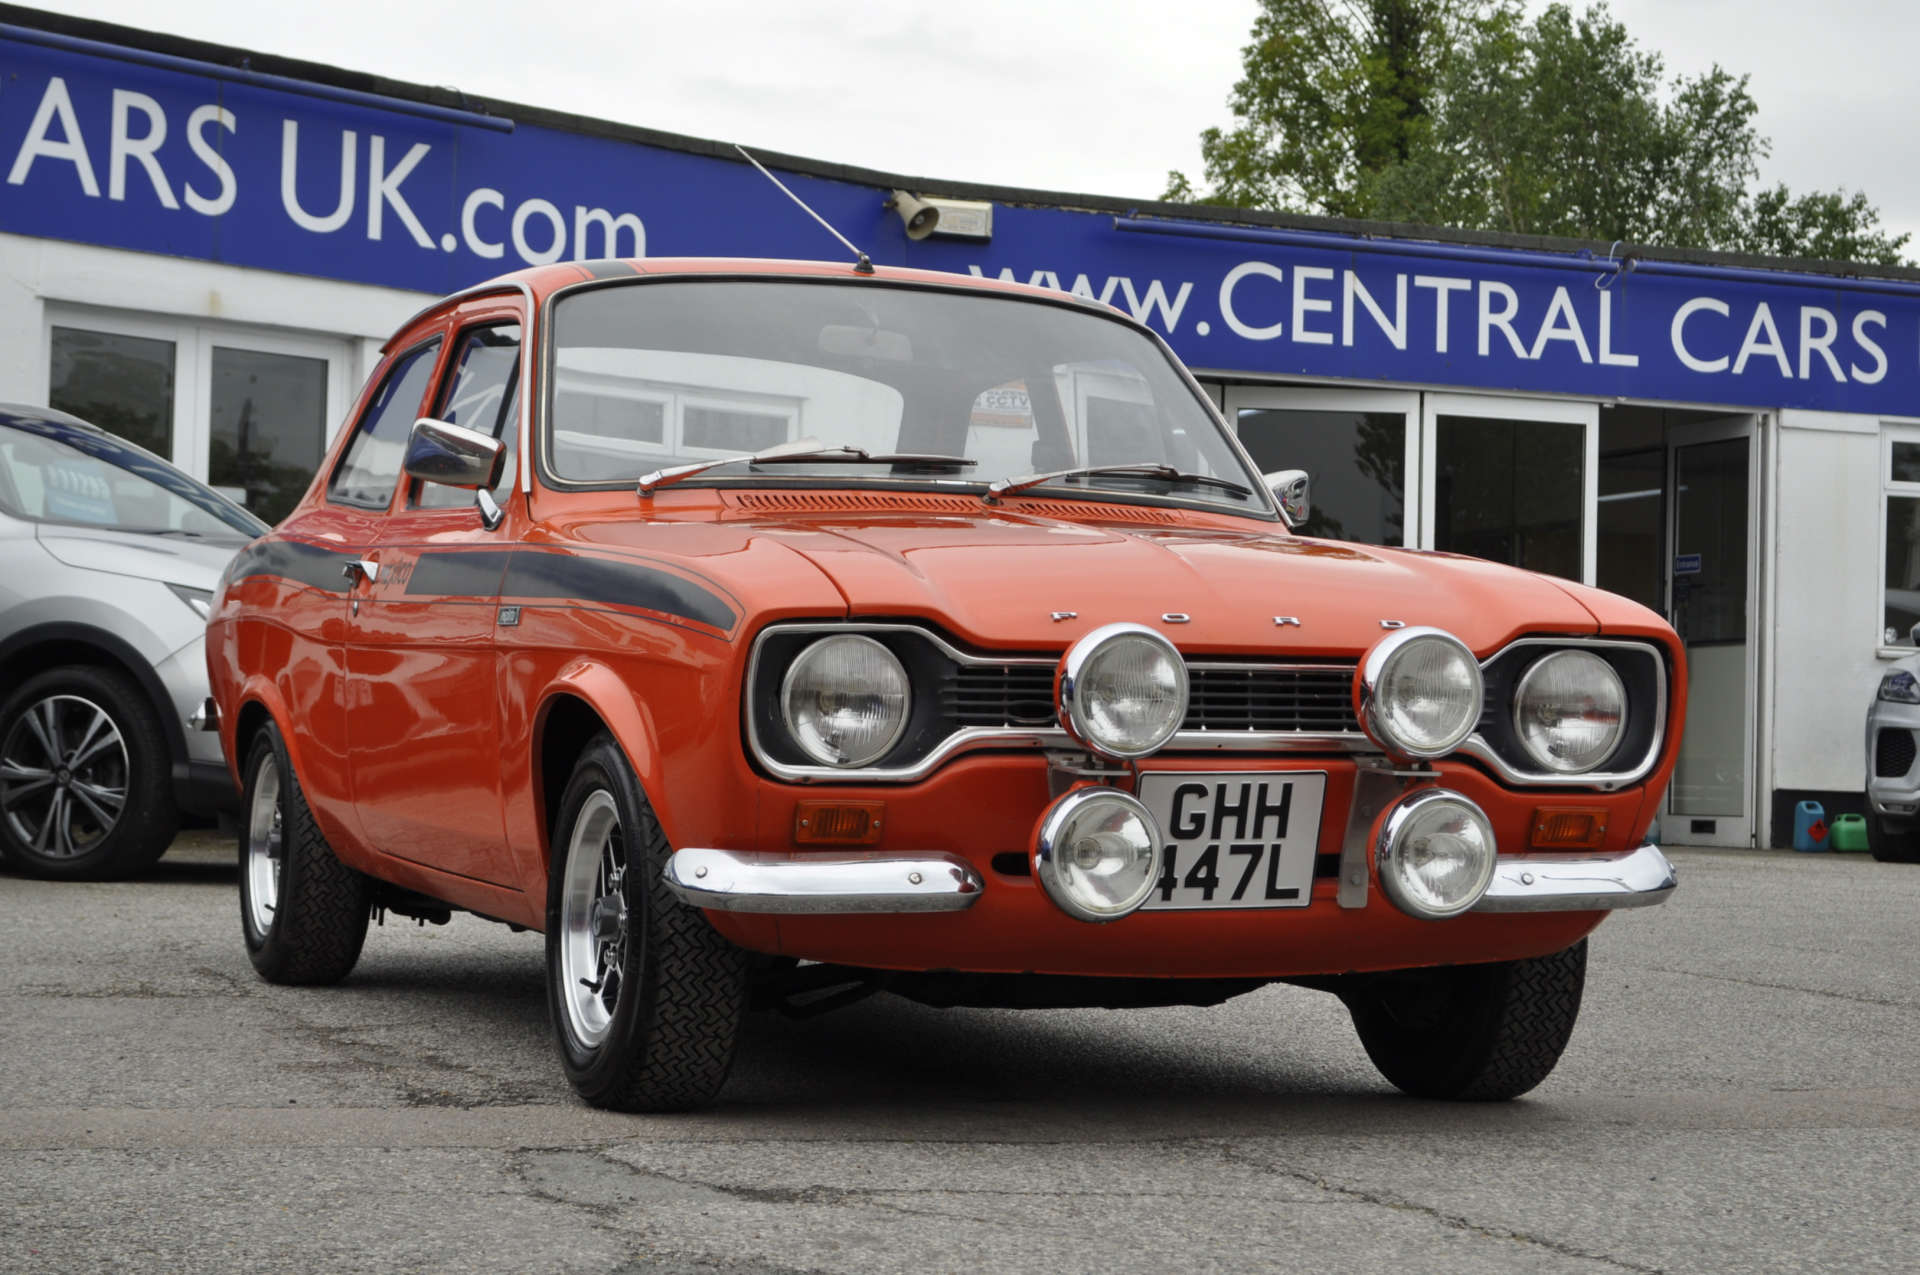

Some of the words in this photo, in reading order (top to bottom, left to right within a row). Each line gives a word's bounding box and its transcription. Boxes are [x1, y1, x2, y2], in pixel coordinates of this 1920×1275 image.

[5, 75, 238, 217] ARS
[280, 118, 647, 266] UK.com
[967, 261, 1640, 368] w.CENTRAL
[1670, 297, 1889, 385] CARS
[985, 395, 1029, 408] CCTV
[1049, 610, 1407, 631] FORD
[1170, 782, 1294, 841] GHH
[1156, 842, 1301, 902] 447L
